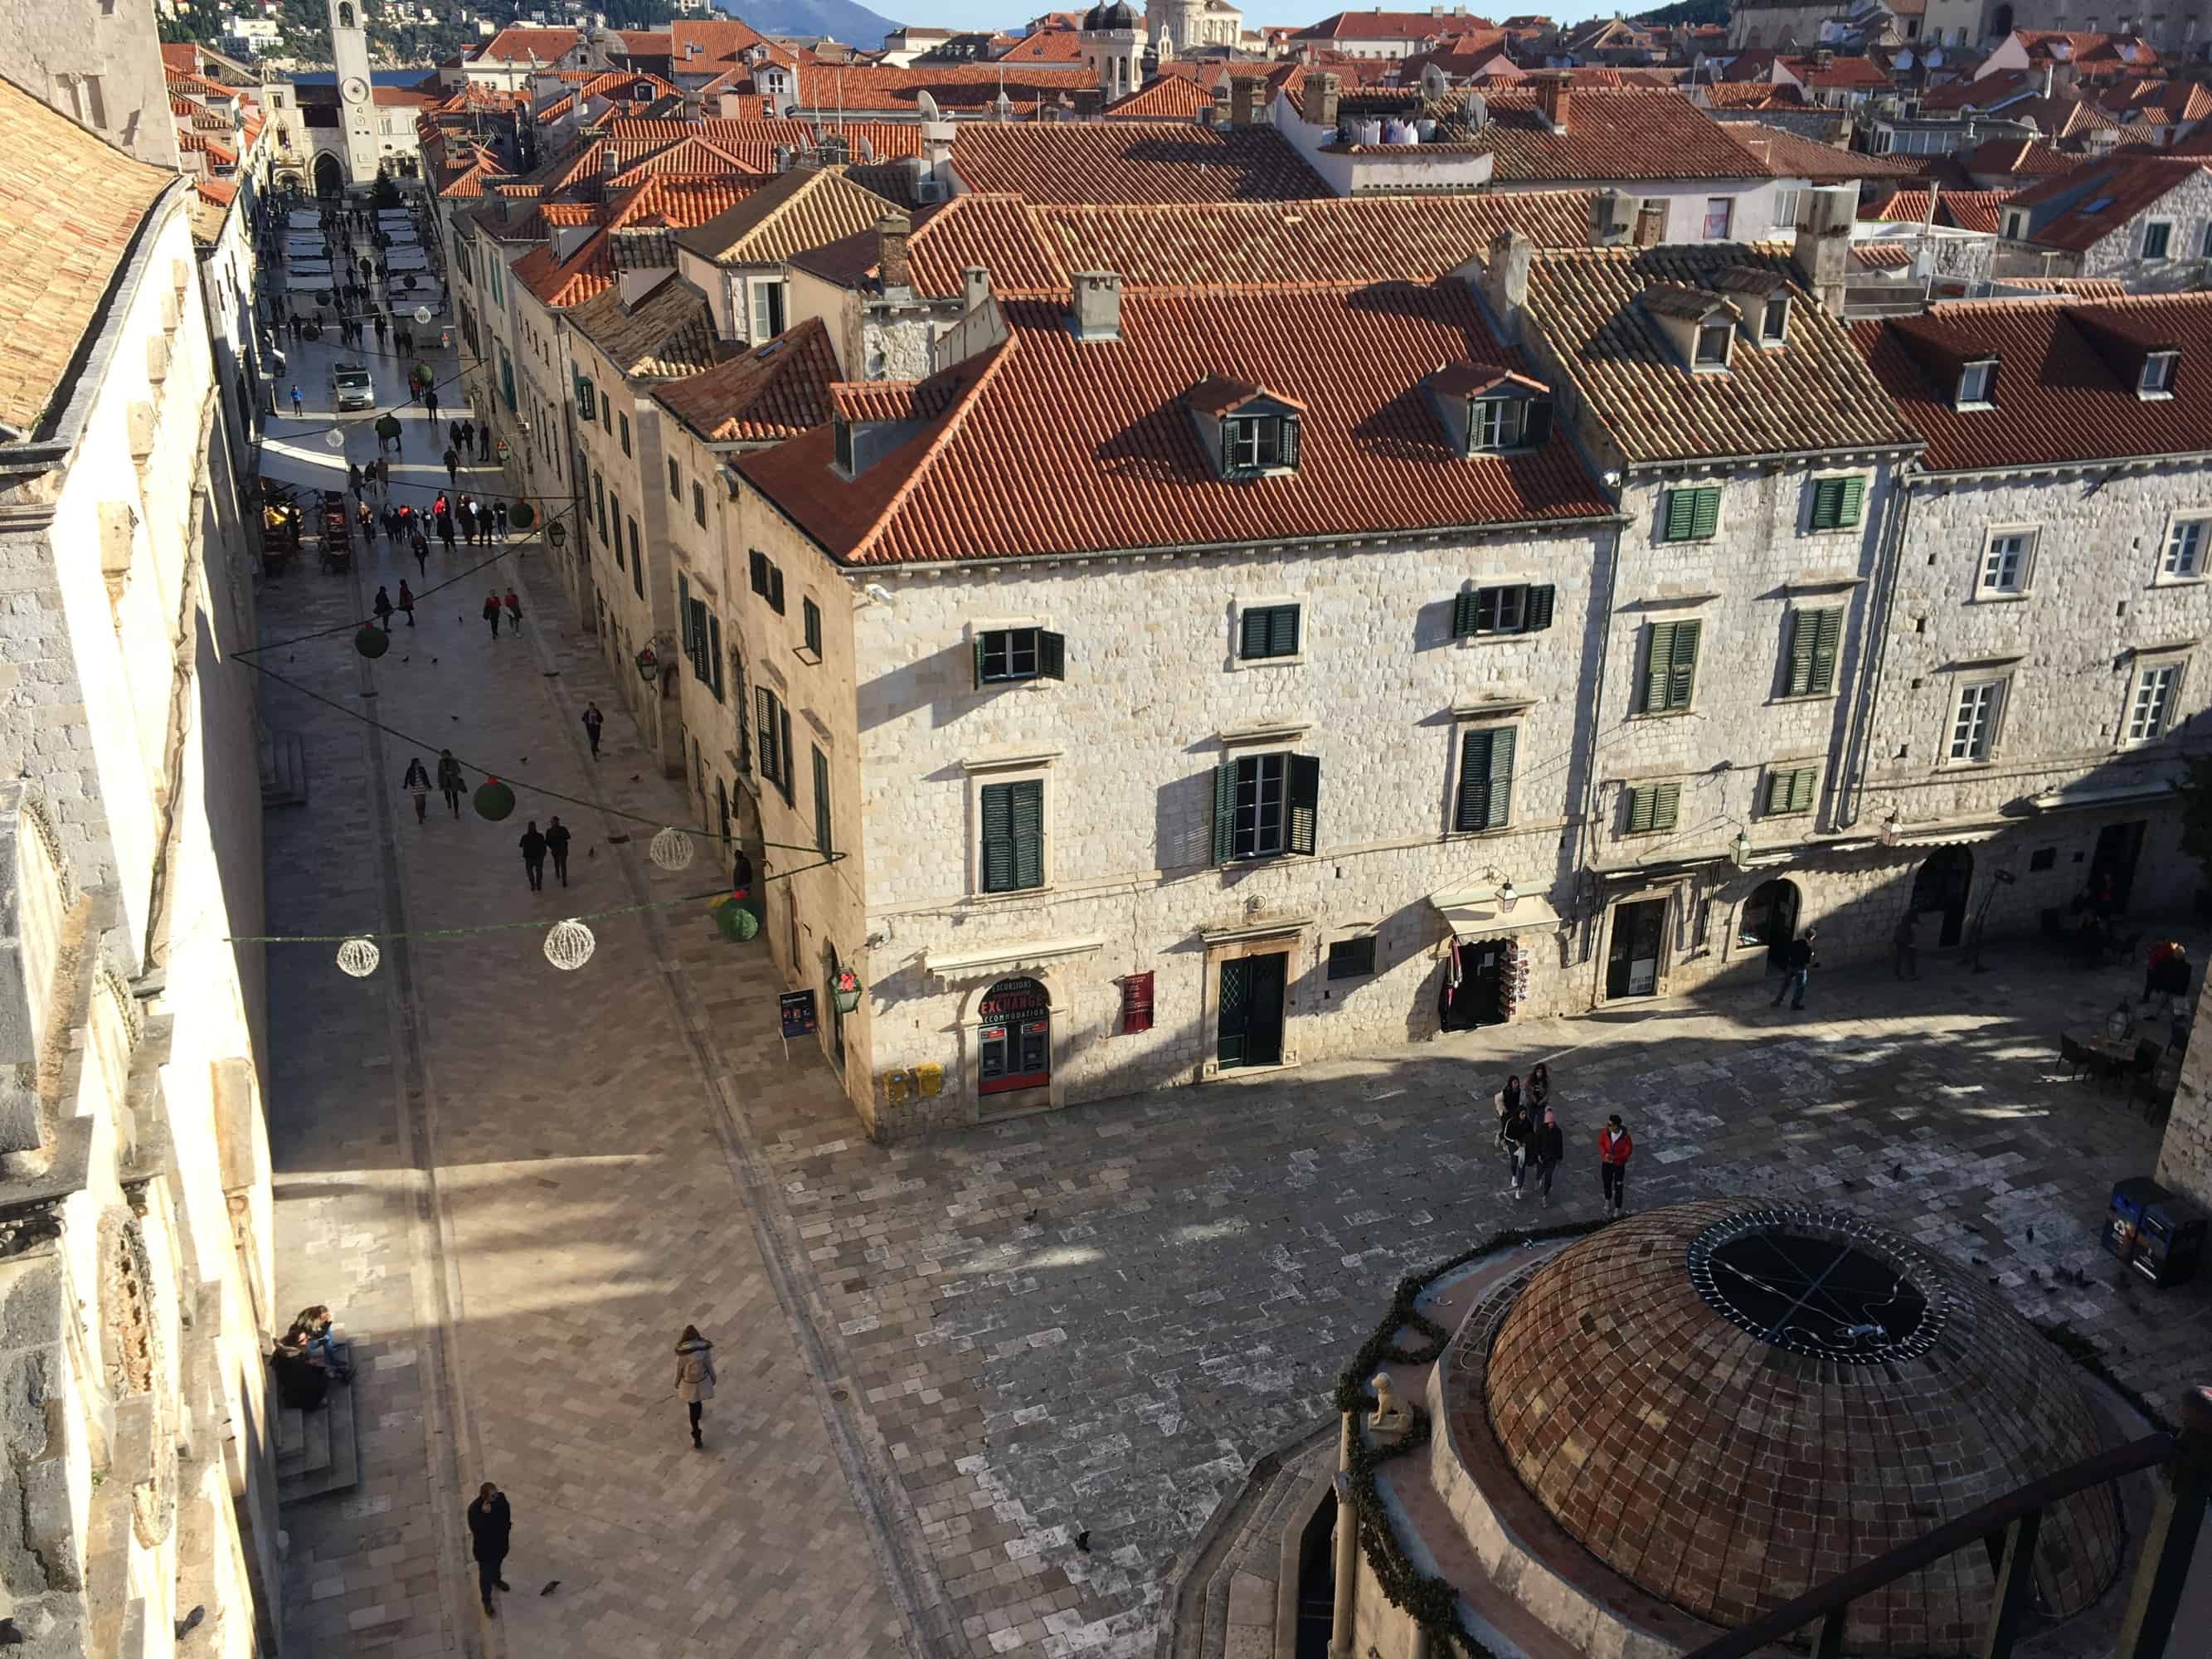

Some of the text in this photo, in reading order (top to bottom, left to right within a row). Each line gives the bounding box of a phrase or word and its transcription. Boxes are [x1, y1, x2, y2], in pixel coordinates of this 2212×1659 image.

[992, 980, 1032, 993] EXCURSIONS
[981, 995, 1043, 1014] EXCHANGE
[984, 1009, 1044, 1023] CCOMMODATION
